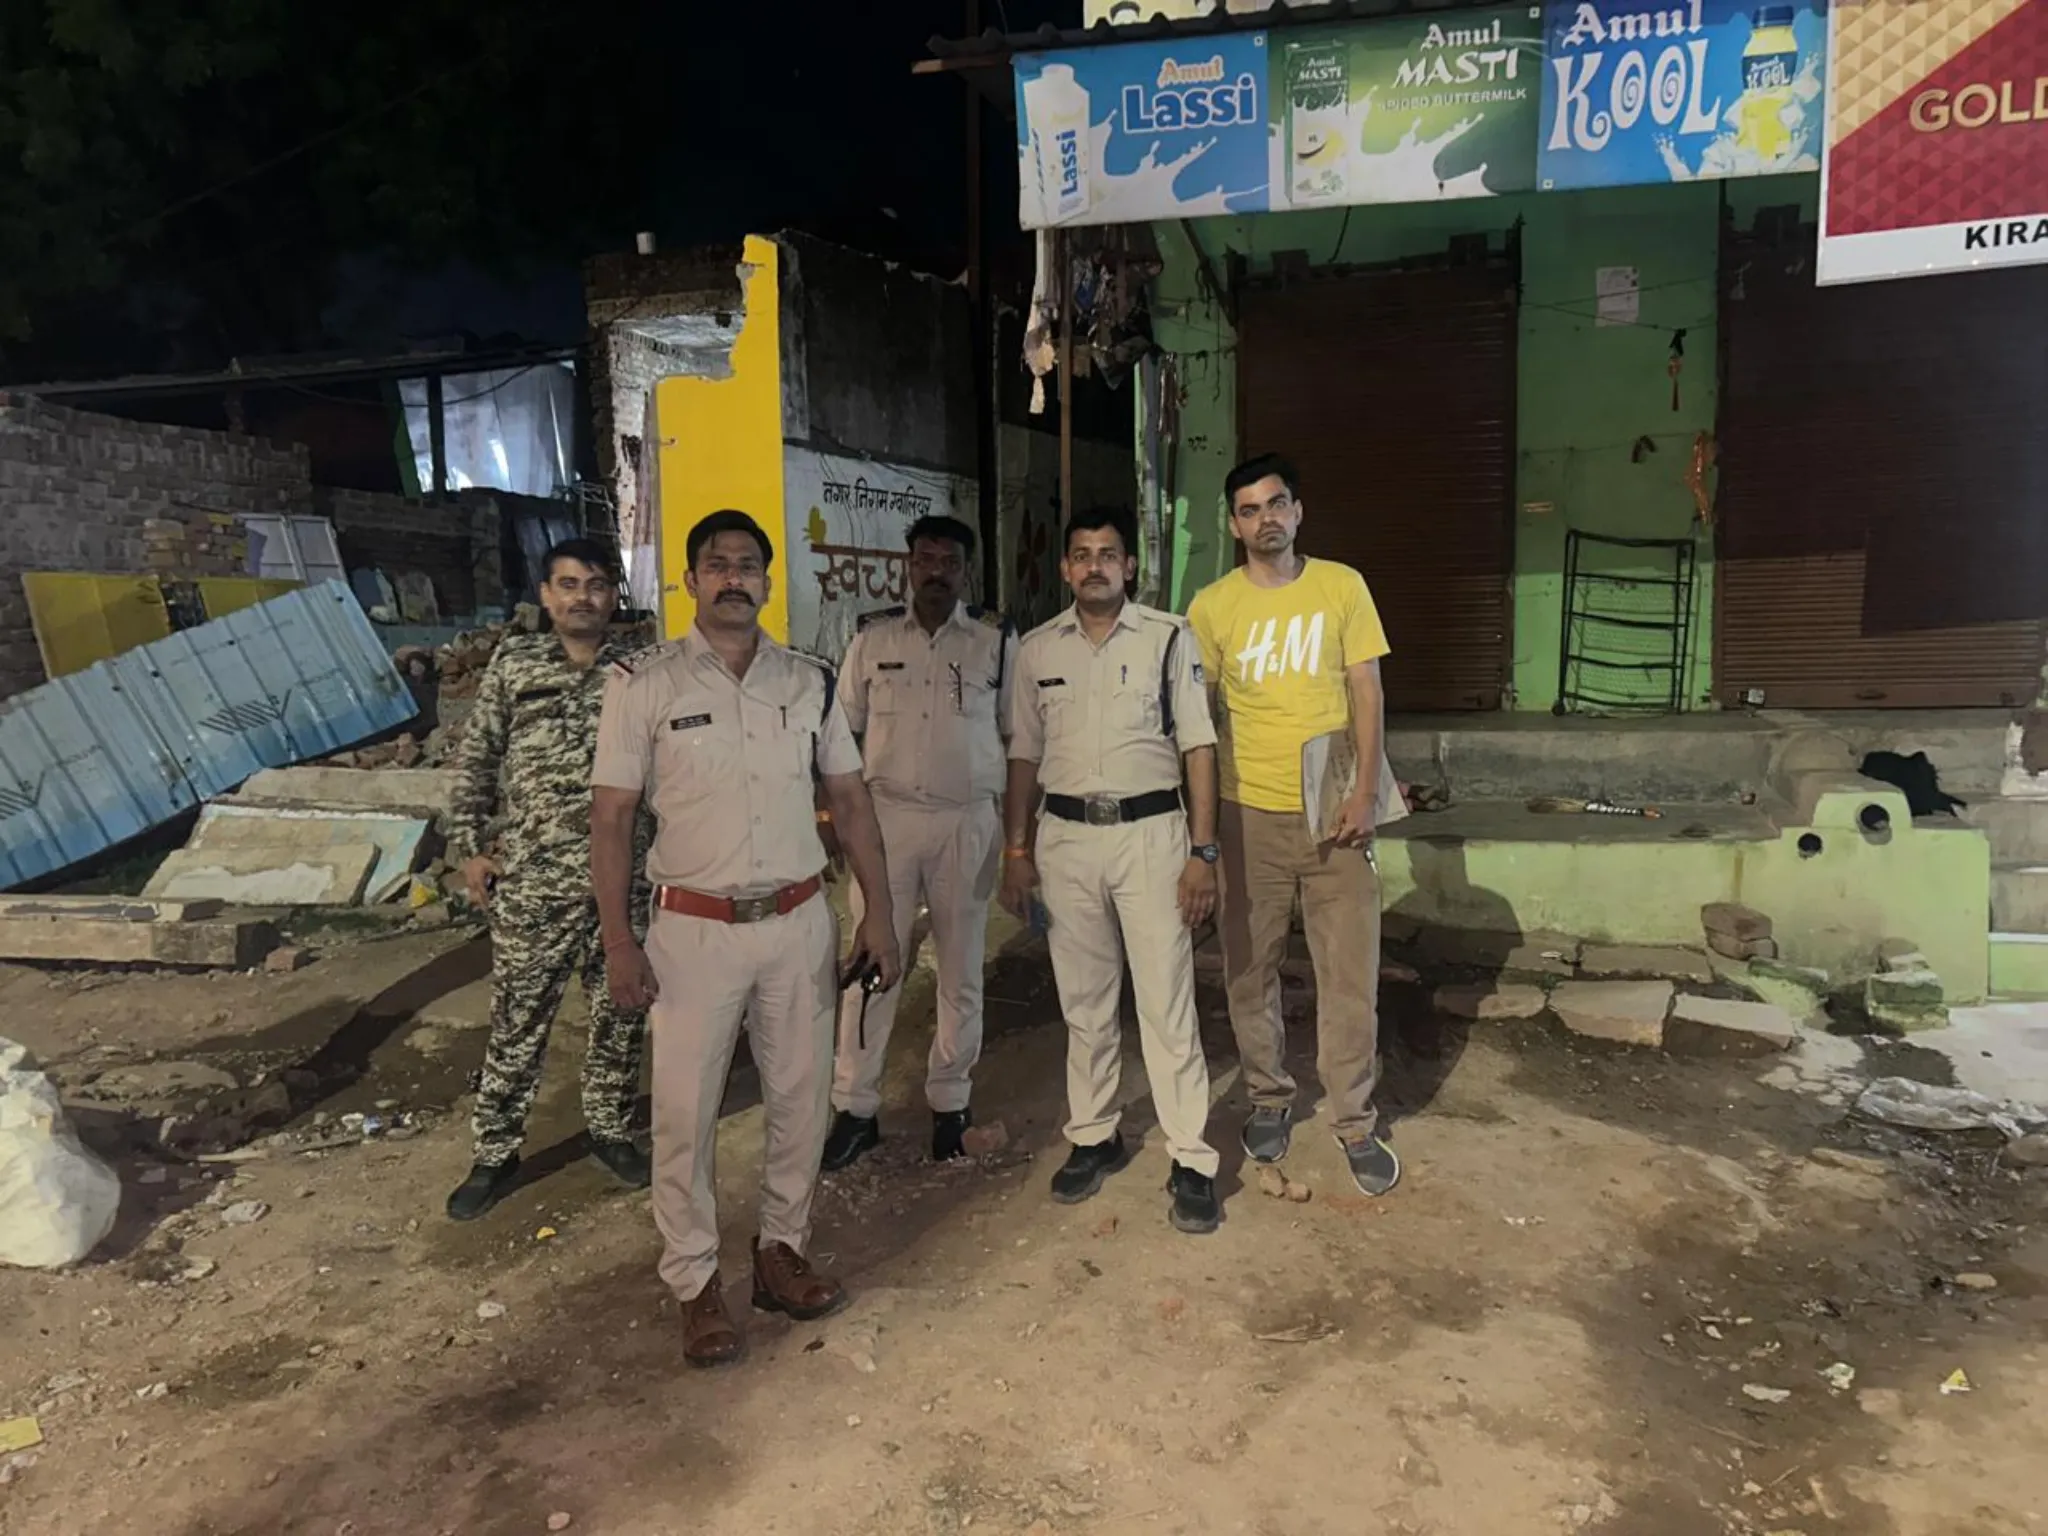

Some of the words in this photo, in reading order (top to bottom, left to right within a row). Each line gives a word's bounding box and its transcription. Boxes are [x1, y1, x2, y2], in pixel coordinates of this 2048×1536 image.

[1420, 18, 1501, 51] Amul
[1562, 0, 1703, 48] Amul
[1157, 55, 1224, 87] Amul
[1297, 65, 1342, 82] MASTI
[1392, 47, 1520, 89] MASTI
[1746, 62, 1790, 90] KOOL
[1122, 73, 1256, 134] Lassi
[1432, 87, 1527, 108] BUTTERMILK
[1547, 38, 1721, 151] KOOL
[1055, 129, 1078, 197] Lassi
[1236, 611, 1325, 684] H&M
